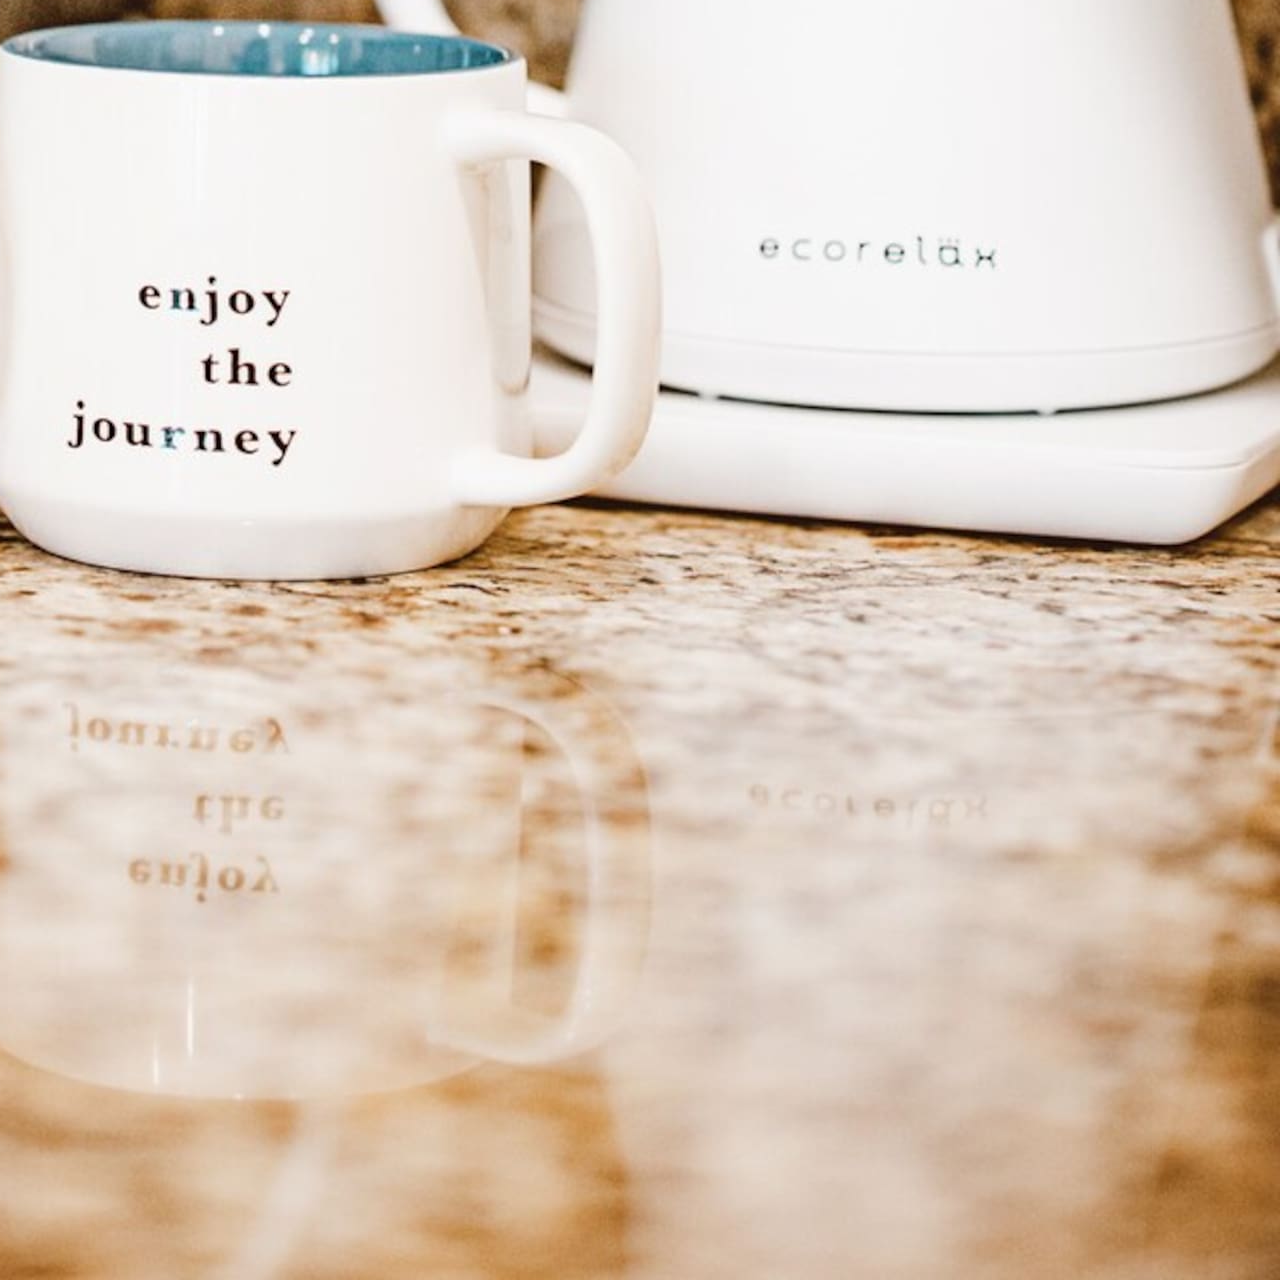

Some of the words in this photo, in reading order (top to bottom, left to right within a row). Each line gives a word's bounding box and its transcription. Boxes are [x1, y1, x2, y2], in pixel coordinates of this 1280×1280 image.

[138, 275, 290, 326] enjoy
[200, 347, 293, 386] the
[67, 400, 296, 466] journey
